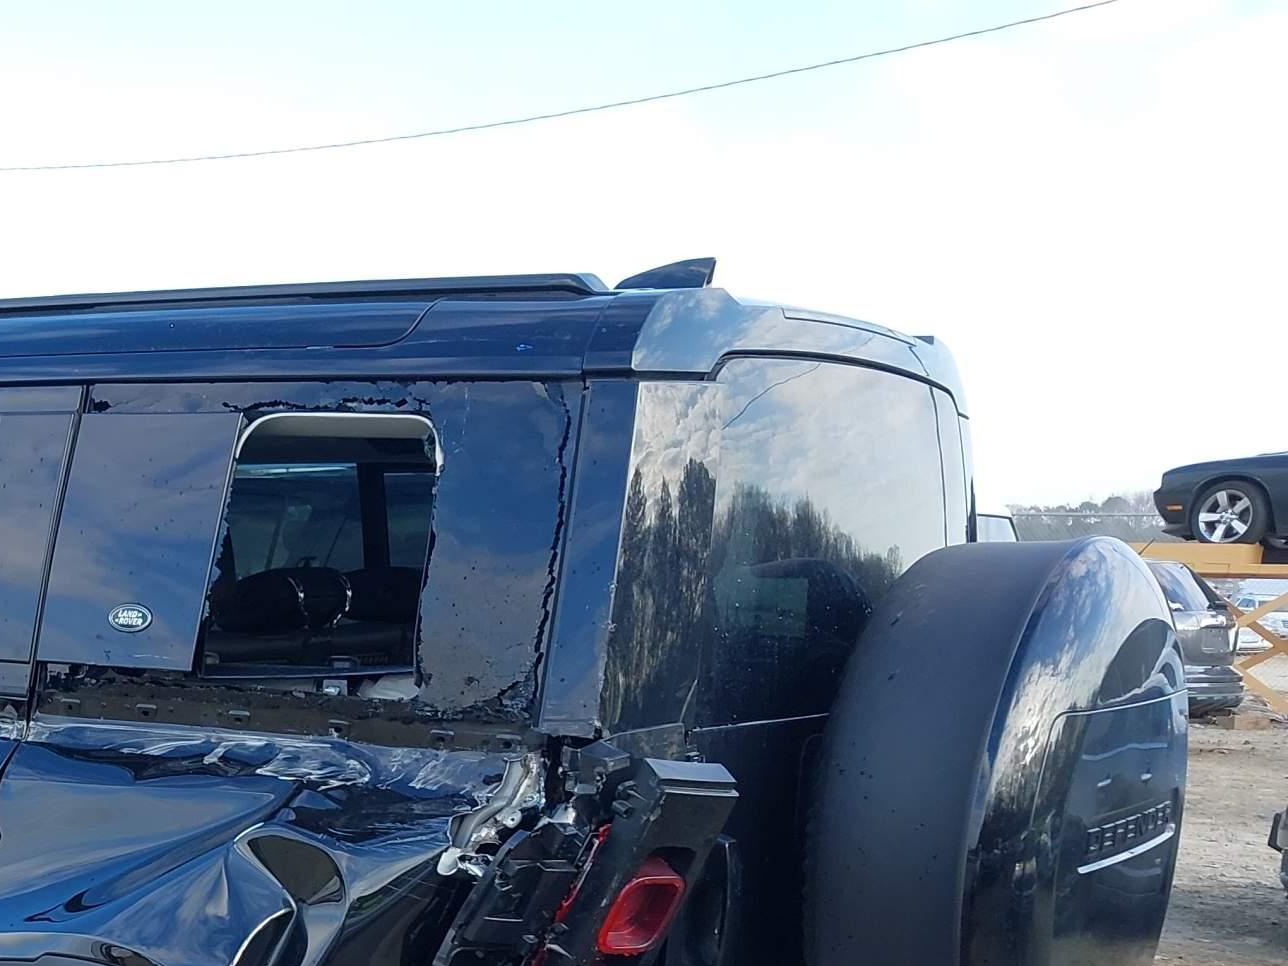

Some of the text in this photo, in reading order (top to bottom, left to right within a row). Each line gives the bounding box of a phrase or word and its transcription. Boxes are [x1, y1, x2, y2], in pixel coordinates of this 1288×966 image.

[117, 609, 138, 618] LAND
[118, 617, 143, 626] ROVER
[1085, 800, 1172, 852] DEFENDER
